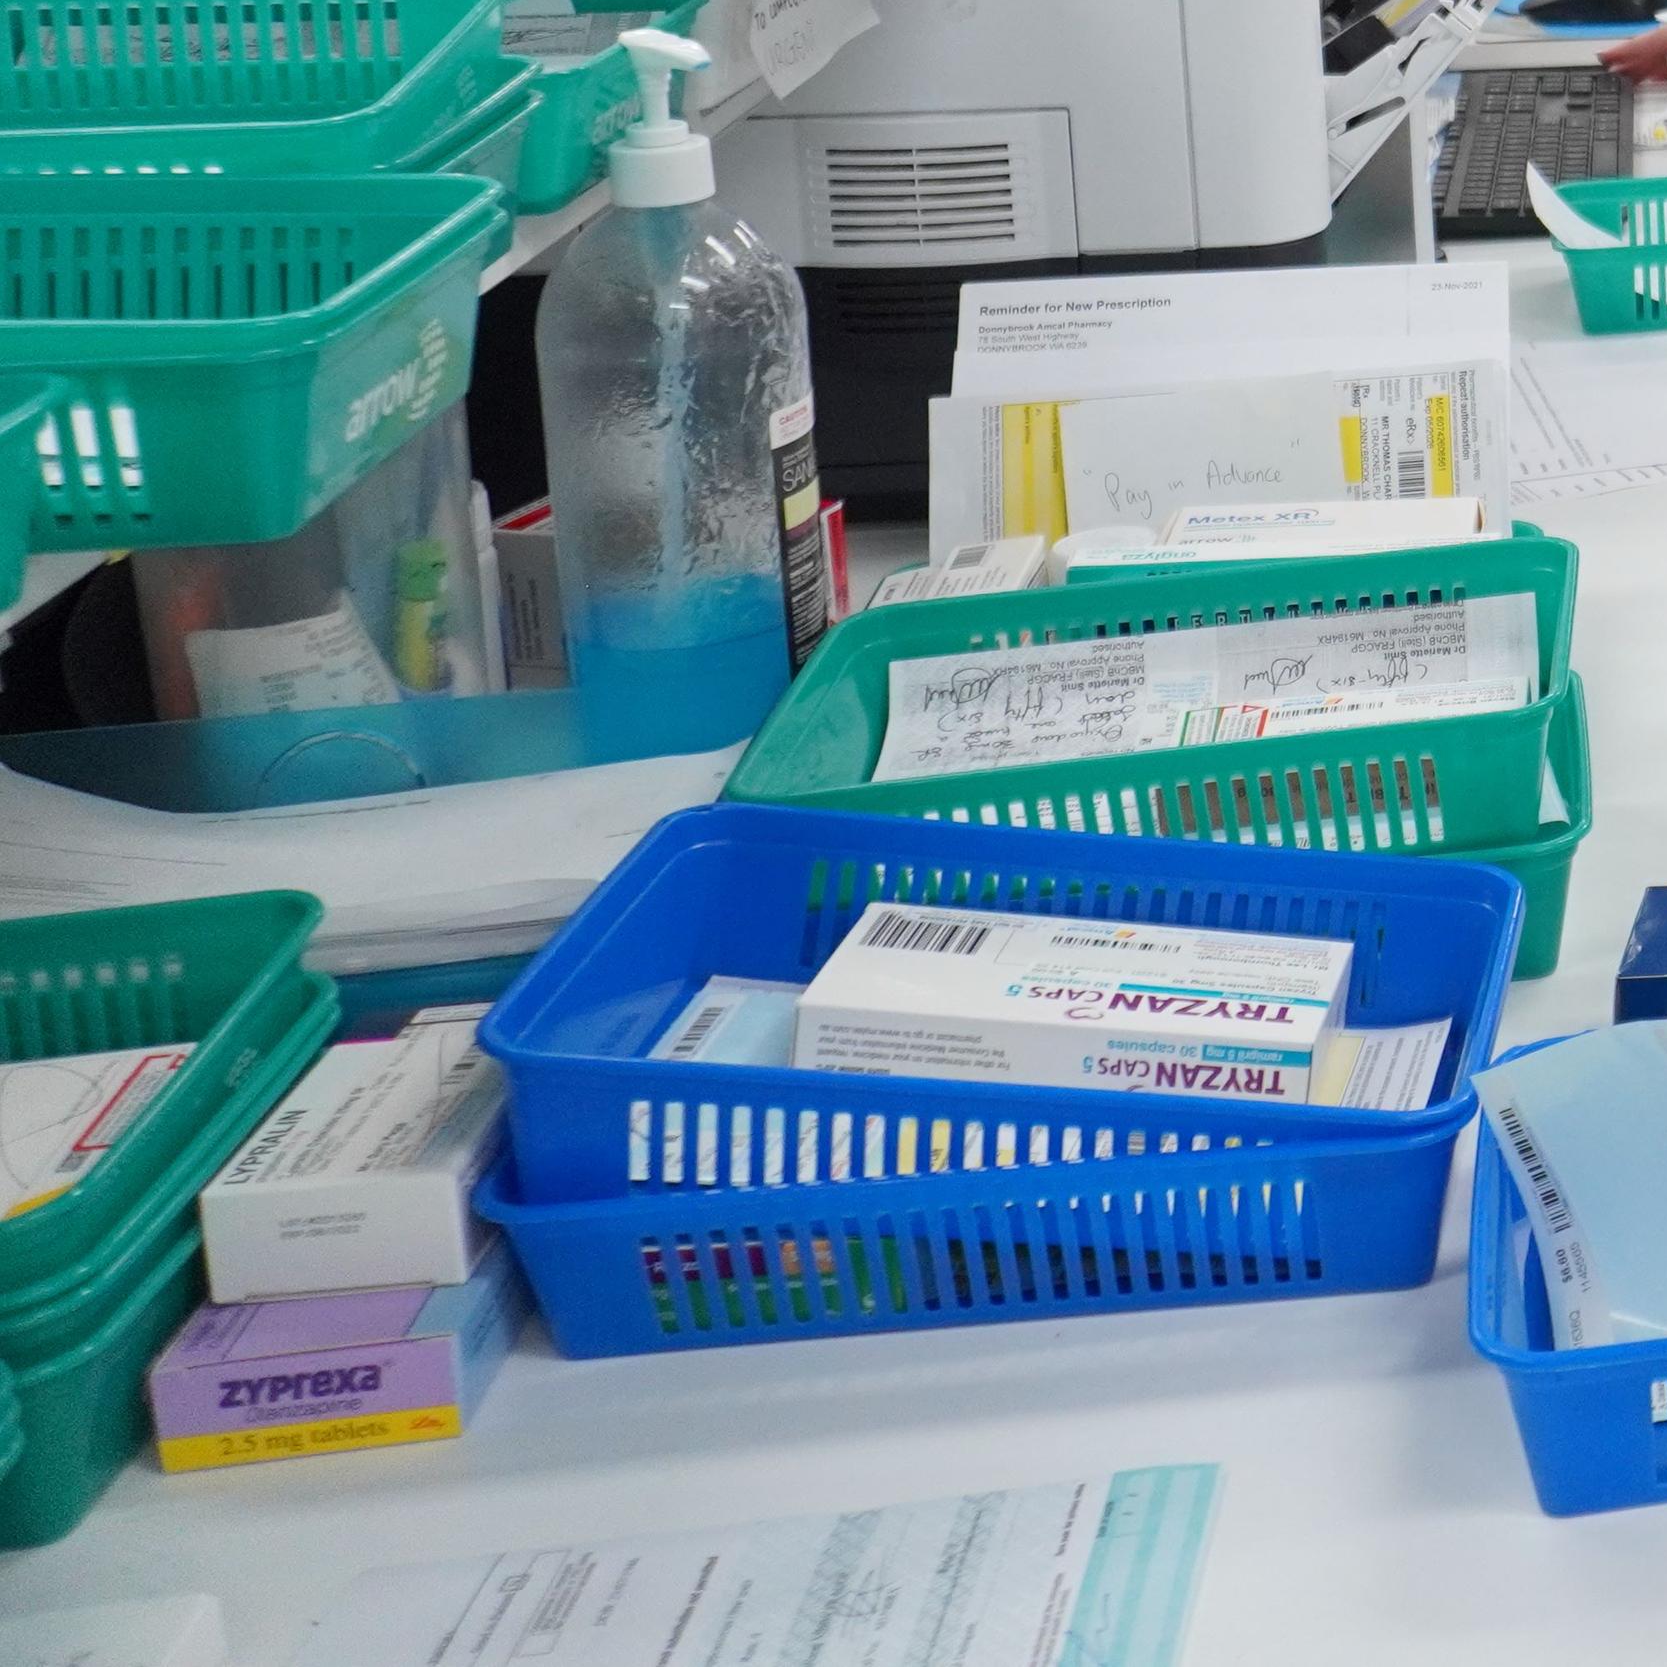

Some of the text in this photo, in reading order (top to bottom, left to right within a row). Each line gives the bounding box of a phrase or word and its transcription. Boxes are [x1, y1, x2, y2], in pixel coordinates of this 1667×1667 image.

[980, 297, 1172, 317] Reminder for New Prescription
[978, 319, 1113, 335] Donnybrook Amcal Pharmacy
[977, 342, 1047, 353] DONNYBROOK
[1381, 415, 1390, 431] MR
[1458, 370, 1470, 461] Repeat authorisation
[1371, 428, 1381, 483] CRACKNELL
[1382, 432, 1391, 472] THOMAS
[1168, 479, 1185, 491] in
[1187, 509, 1314, 525] Metex XR
[1178, 535, 1233, 546] arrow
[1388, 622, 1433, 638] Approval
[1434, 621, 1466, 633] Phone
[1350, 640, 1396, 654] FRACGP
[1454, 645, 1466, 655] Dr
[1067, 654, 1111, 669] Approval
[1112, 653, 1145, 665] Phone
[1383, 650, 1408, 662] Smit
[1060, 681, 1086, 693] Smit
[1131, 675, 1146, 687] Dr
[1005, 984, 1295, 1024] TRYZAN CAPS 5
[1106, 1038, 1177, 1056] capsules
[1180, 1046, 1199, 1058] 30
[1204, 1045, 1227, 1058] mg
[1237, 1050, 1283, 1064] ramipril
[1082, 1055, 1286, 1096] TRYZAN CAPS 5
[223, 1109, 308, 1185] LYPRALIN
[220, 1422, 391, 1456] 2.5 mg tablets
